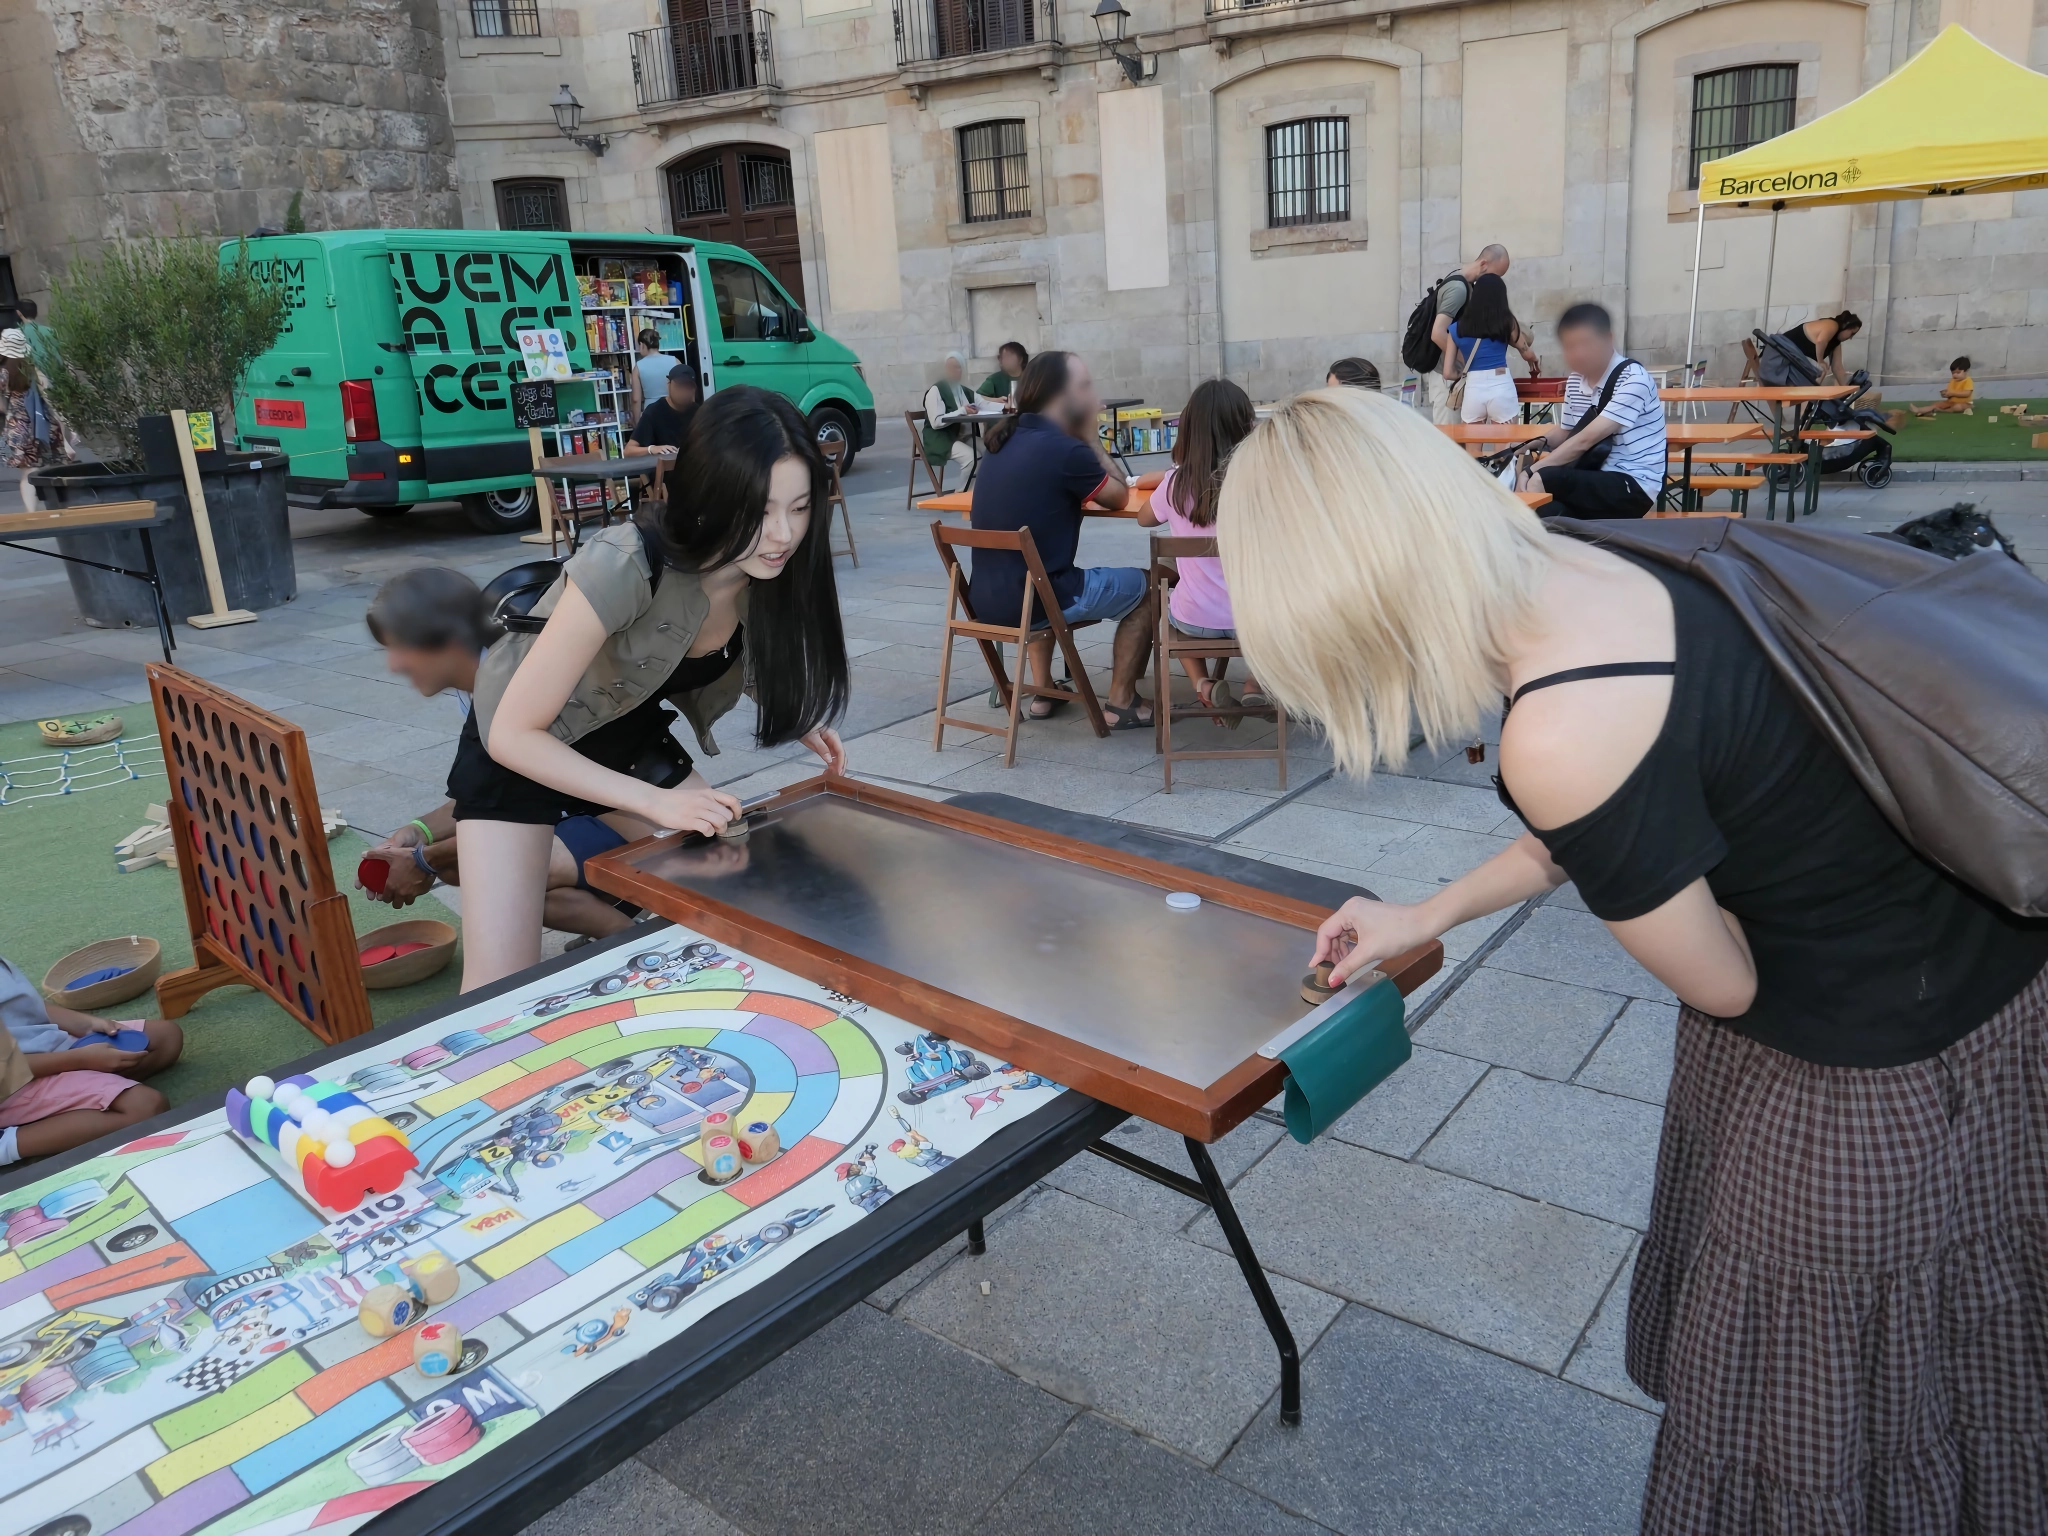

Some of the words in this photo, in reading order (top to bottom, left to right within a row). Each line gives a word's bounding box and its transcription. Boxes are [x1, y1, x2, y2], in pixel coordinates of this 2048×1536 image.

[1719, 171, 1838, 196] Barcelona
[402, 306, 452, 356] A
[470, 1210, 514, 1231] HABA
[195, 1266, 278, 1308] MONZA
